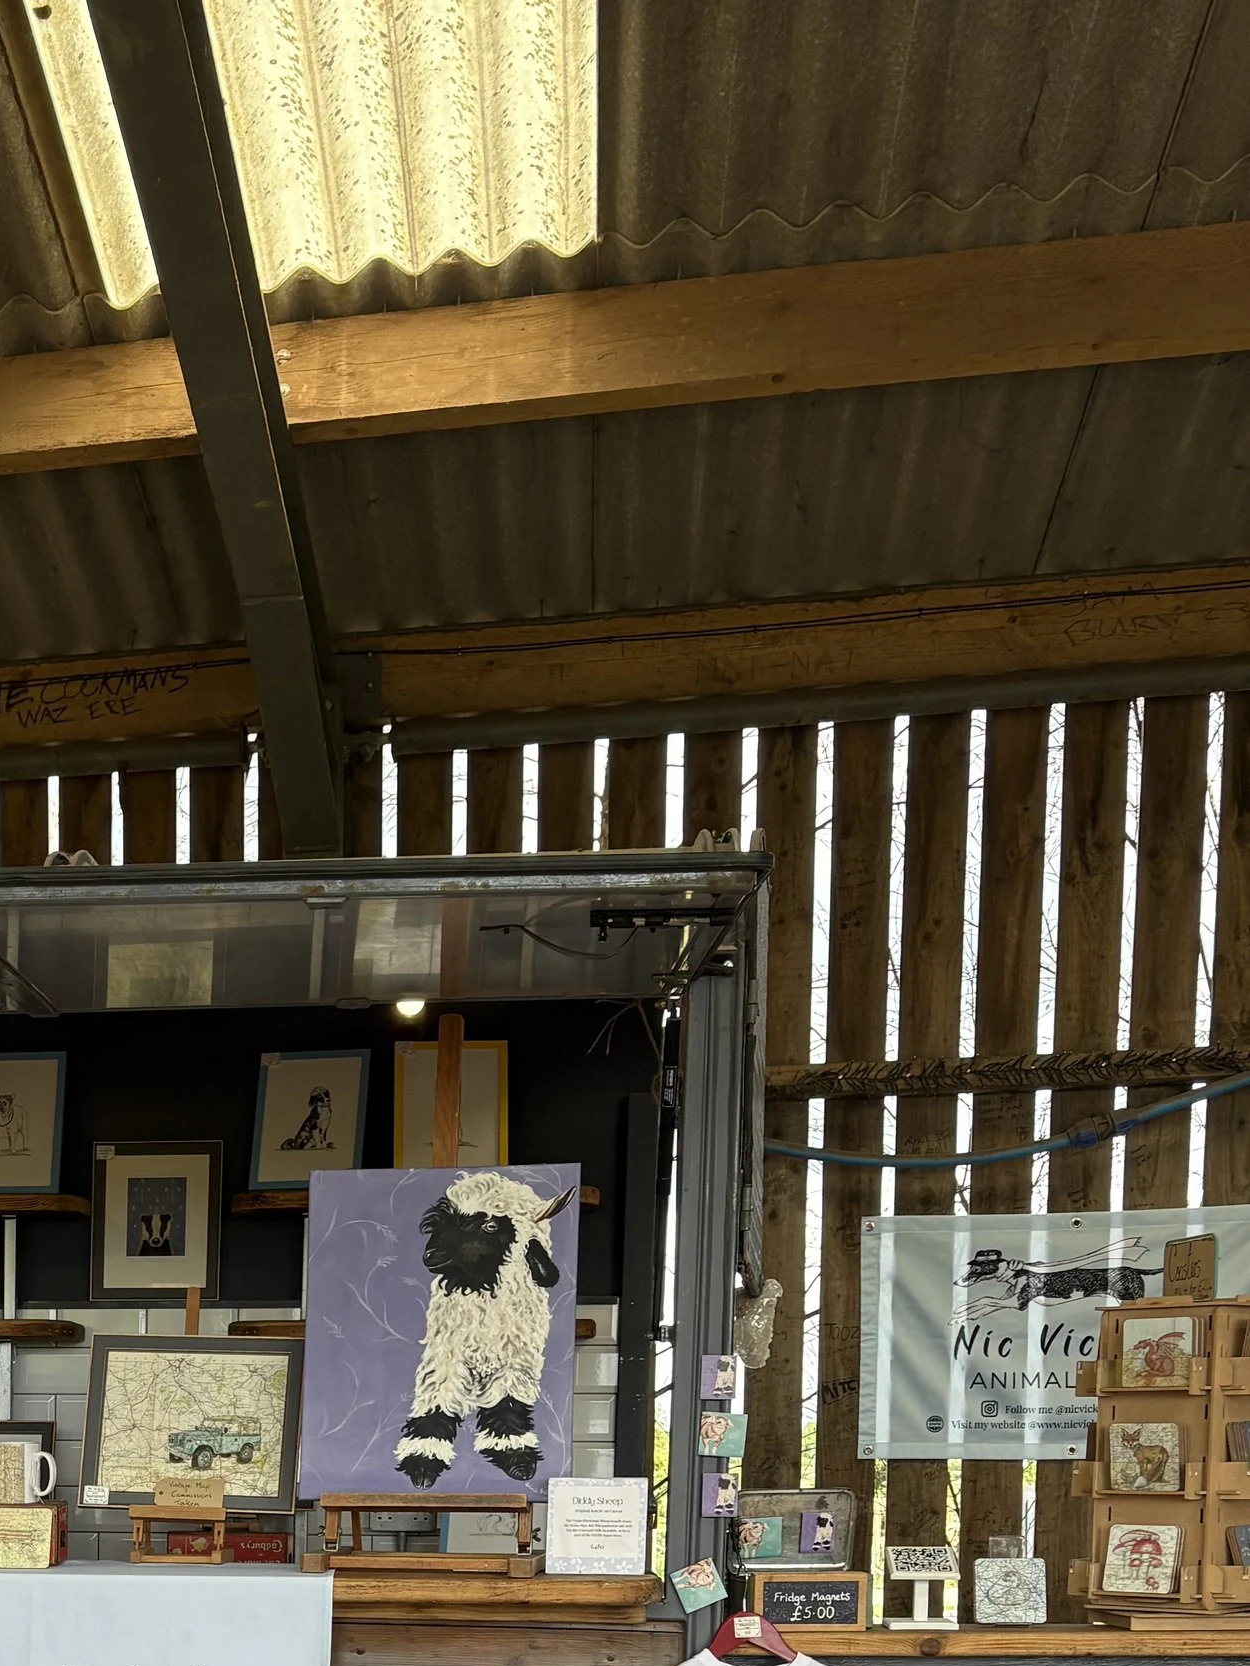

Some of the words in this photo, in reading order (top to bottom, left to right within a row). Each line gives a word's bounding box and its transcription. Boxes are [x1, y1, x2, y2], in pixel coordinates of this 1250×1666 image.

[16, 705, 75, 729] WAZ
[86, 696, 145, 721] ERE
[953, 1322, 1013, 1361] Nic
[1040, 1322, 1095, 1358] Vic
[969, 1371, 1076, 1389] ANIMAL
[1005, 1404, 1037, 1414] Follow
[1038, 1406, 1053, 1414] me
[951, 1420, 972, 1429] Visit
[974, 1421, 988, 1431] my
[993, 1420, 1026, 1430] website
[195, 1481, 211, 1493] Map
[174, 1499, 200, 1507] Taken
[572, 1496, 596, 1507] Diddy
[597, 1497, 624, 1507] Sheep
[773, 1591, 807, 1606] Fridge
[811, 1591, 851, 1606] Magnets
